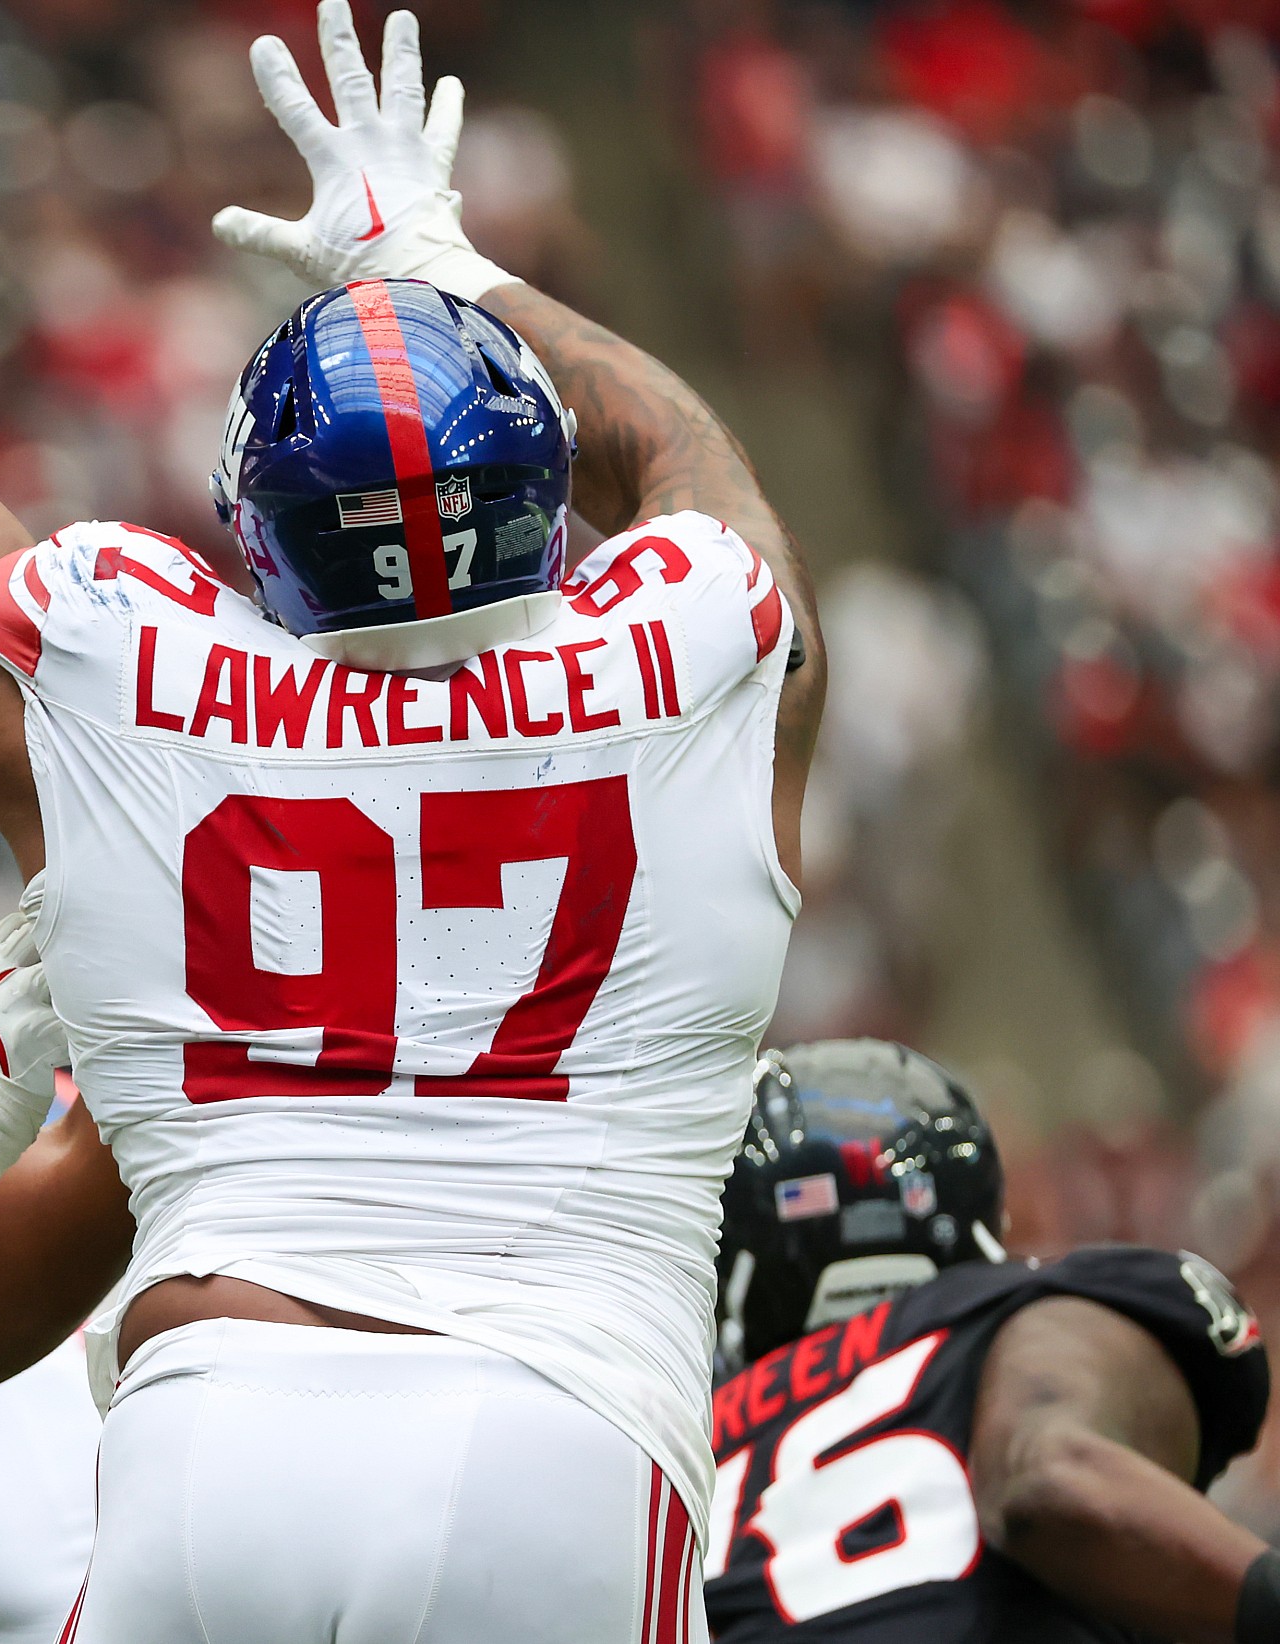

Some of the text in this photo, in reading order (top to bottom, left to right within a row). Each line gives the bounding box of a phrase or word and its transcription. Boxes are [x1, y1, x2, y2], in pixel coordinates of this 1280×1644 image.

[373, 528, 478, 600] 97
[442, 492, 469, 514] NFL
[135, 620, 682, 748] LAWRENCE II
[182, 774, 638, 1104] 97
[712, 1301, 892, 1450] REEN
